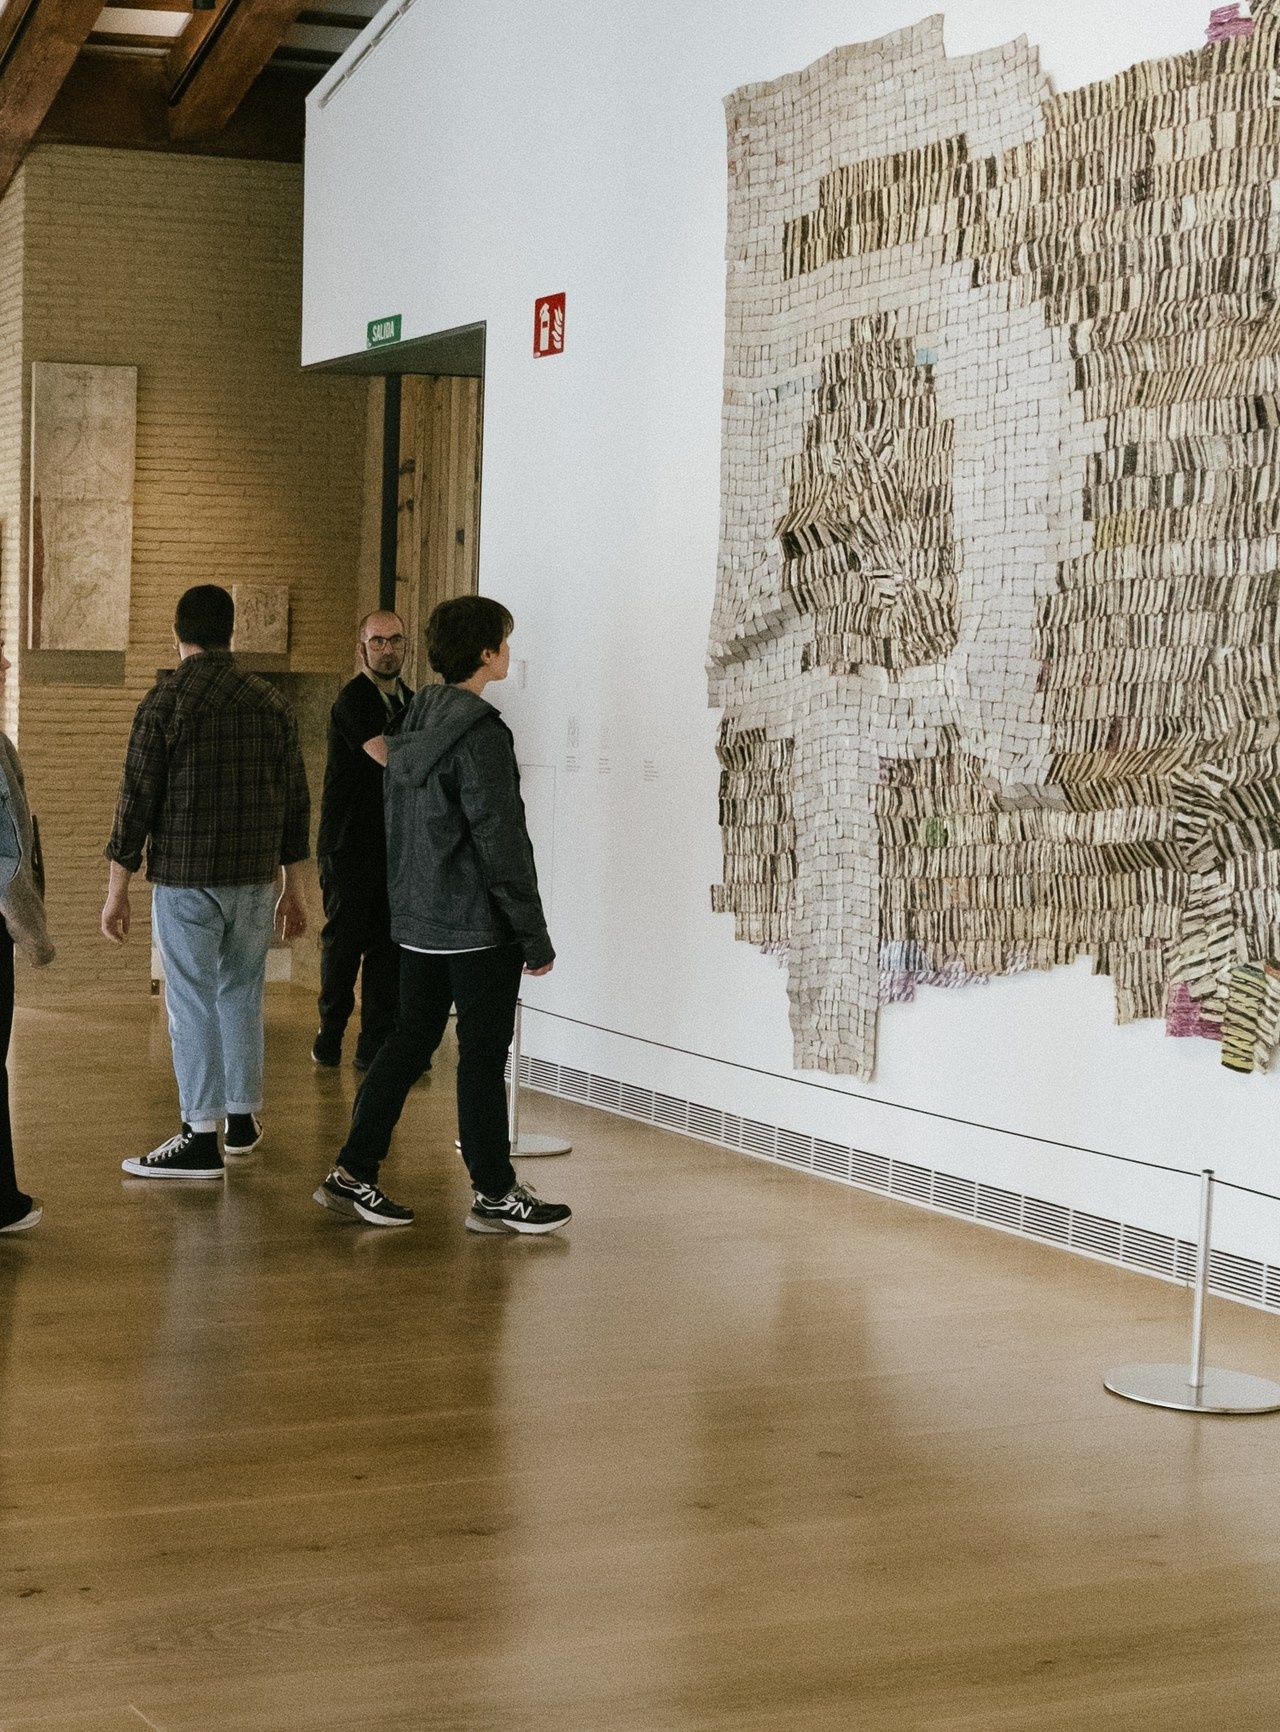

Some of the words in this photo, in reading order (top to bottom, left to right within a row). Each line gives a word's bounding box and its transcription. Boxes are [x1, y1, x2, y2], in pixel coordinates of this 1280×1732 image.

[372, 320, 395, 342] SALIDA
[361, 1190, 383, 1208] N
[511, 1201, 532, 1219] N
